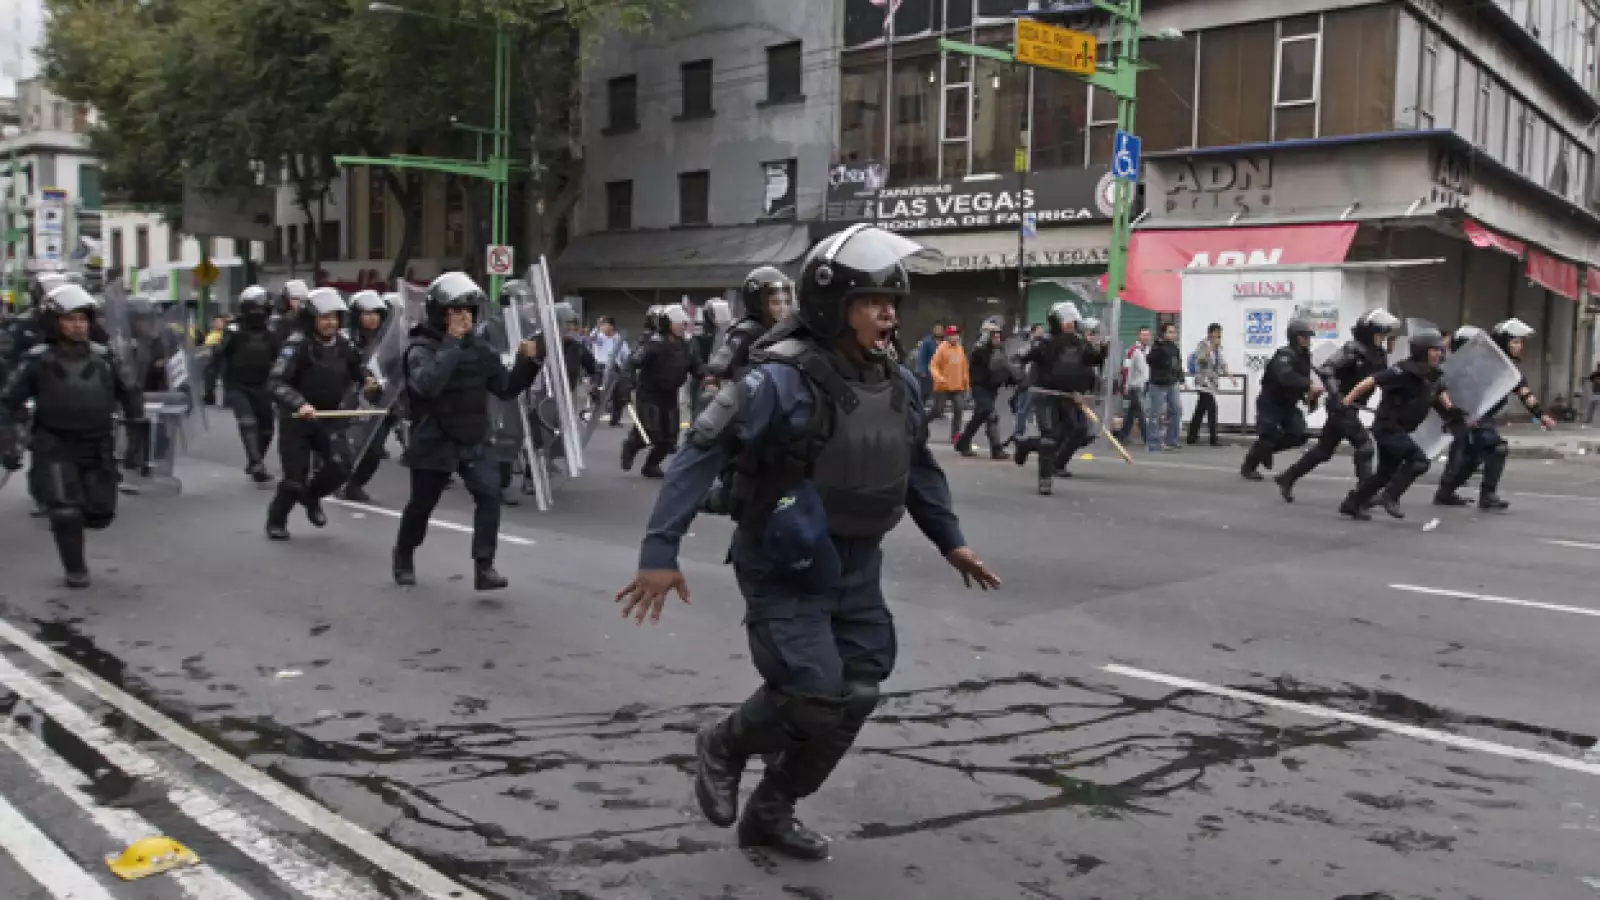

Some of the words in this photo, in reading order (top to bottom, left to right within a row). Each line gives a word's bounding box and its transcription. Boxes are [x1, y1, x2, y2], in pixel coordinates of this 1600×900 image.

[1166, 157, 1273, 194] ADN
[877, 196, 928, 219] LAS
[935, 190, 1034, 214] VEGAS
[962, 214, 990, 227] DE
